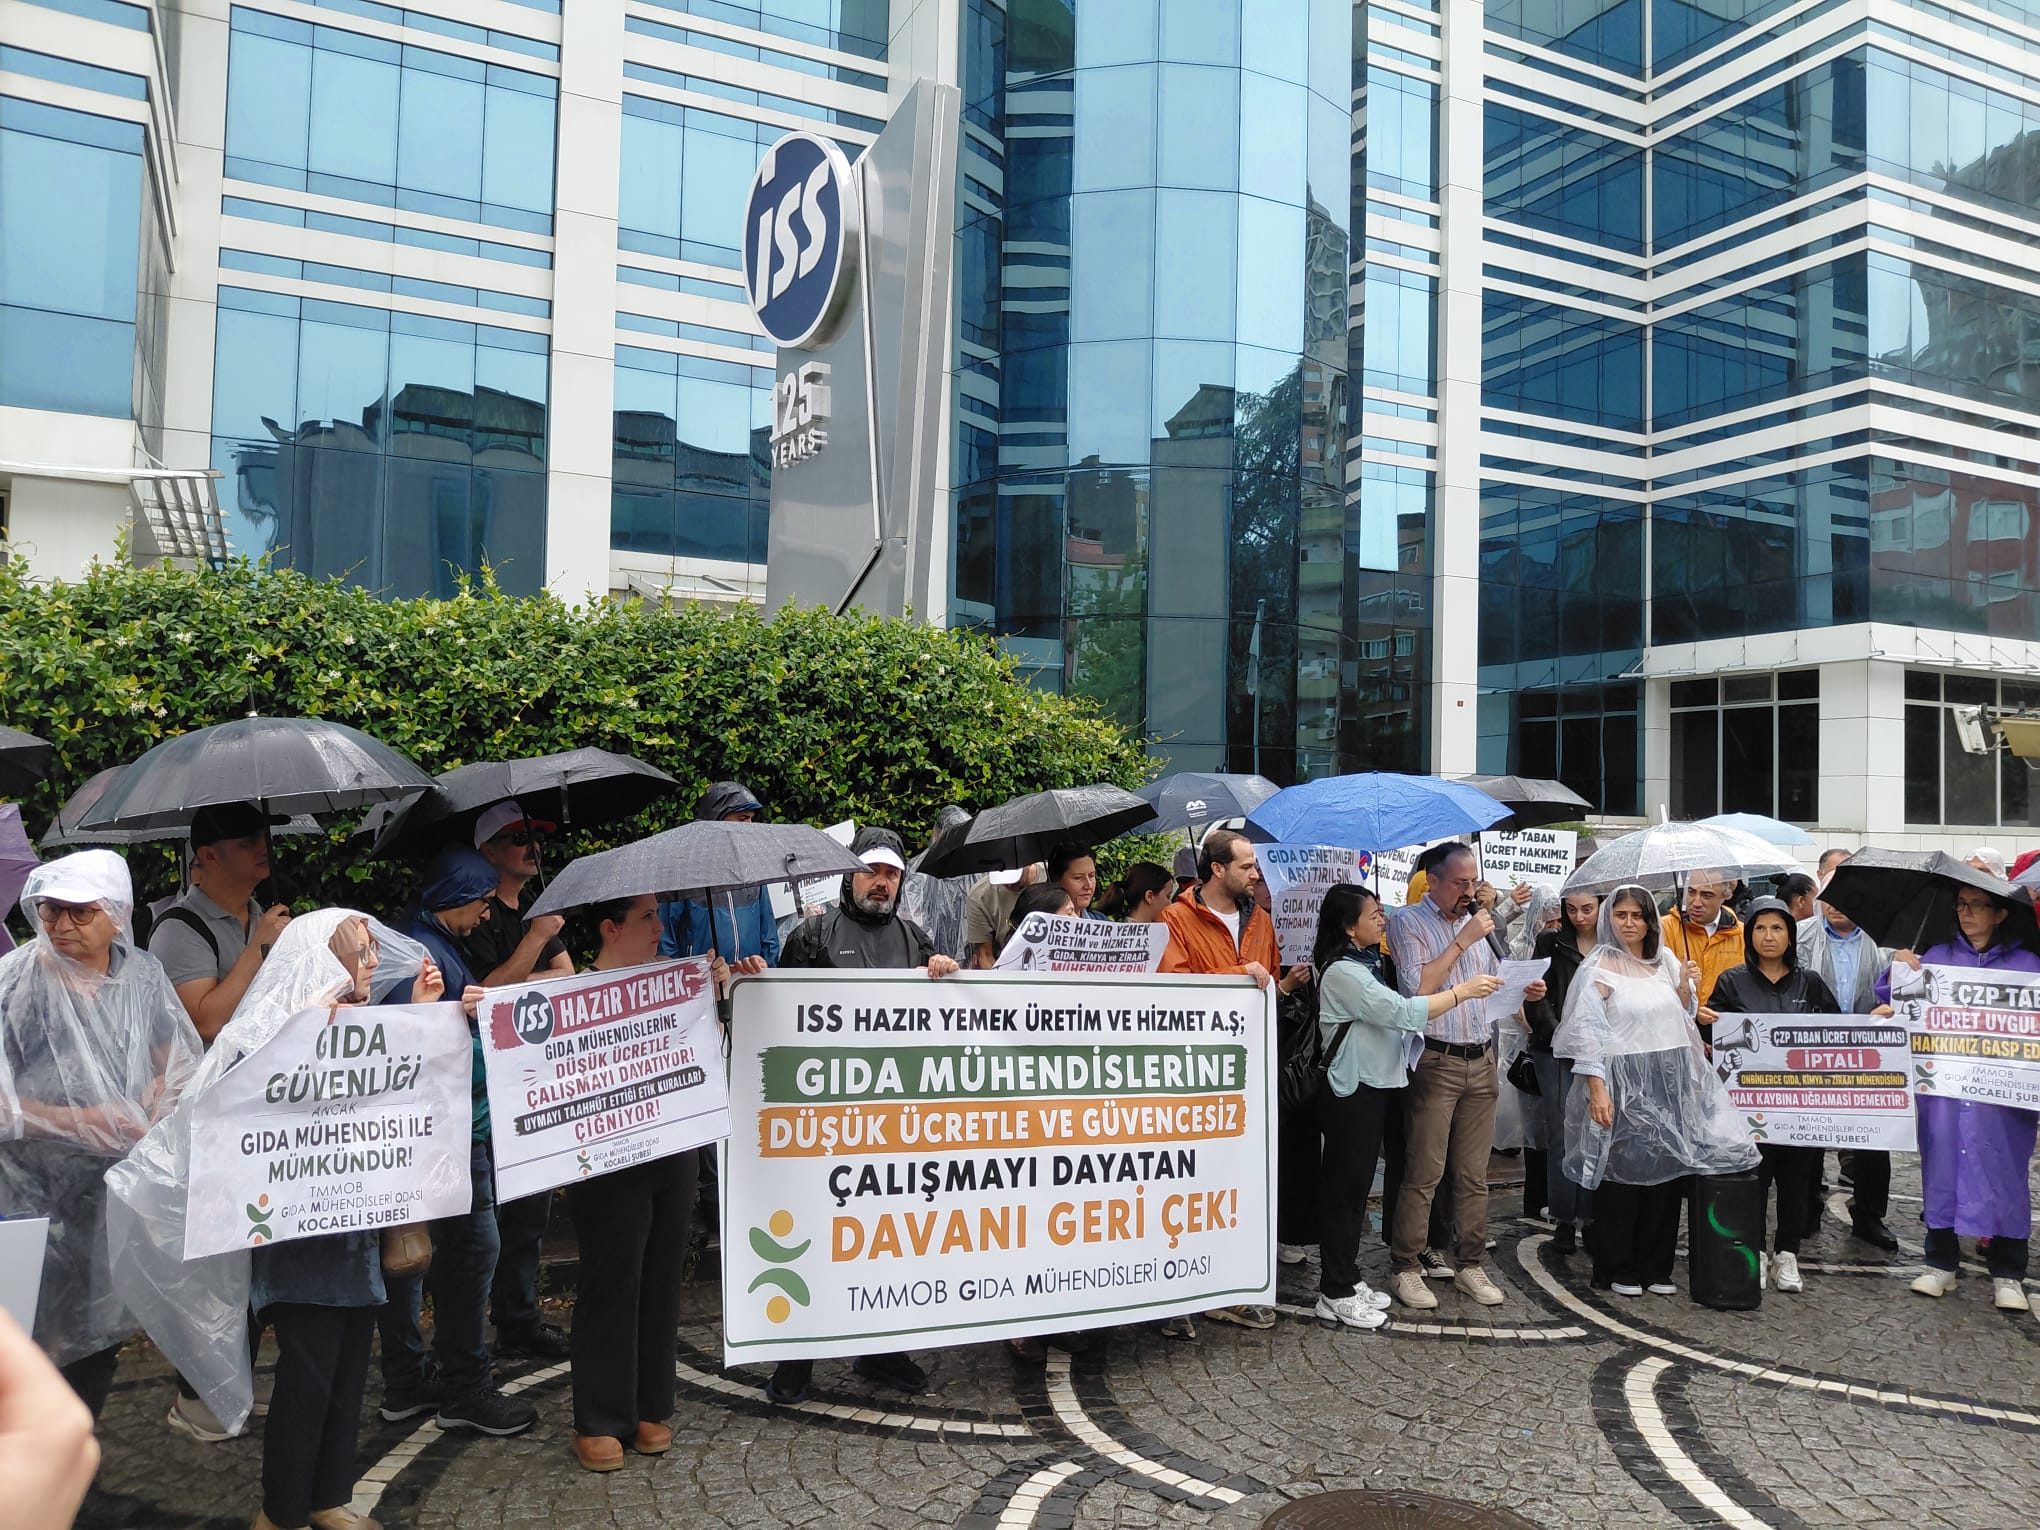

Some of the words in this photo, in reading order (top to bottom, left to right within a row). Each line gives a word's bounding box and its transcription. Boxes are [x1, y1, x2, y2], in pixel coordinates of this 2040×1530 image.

[755, 148, 830, 313] ISS
[769, 361, 814, 443] 125
[771, 427, 817, 468] YEARS
[1500, 831, 1518, 842] ÇZP
[1521, 832, 1555, 843] TABAN
[1267, 850, 1298, 864] GIDA
[1485, 842, 1517, 856] ÜCRET
[1520, 847, 1568, 860] HAKKIMIZ
[1484, 860, 1510, 870] GASP
[1513, 861, 1561, 875] EDİLEMEZ
[1282, 899, 1303, 913] GIDA
[1050, 919, 1070, 934] ISS
[1074, 923, 1112, 937] HAZIR
[1116, 924, 1150, 937] YEMEK
[1047, 933, 1086, 949] ÜRETİM
[1089, 940, 1099, 948] ve
[1102, 937, 1133, 949] HİZMET
[1080, 950, 1106, 962] KİMYA
[1108, 954, 1117, 962] ve
[1119, 951, 1146, 961] ZİRAAT
[1958, 984, 1999, 1008] ÇZP
[797, 1004, 843, 1033] ISS
[854, 1008, 931, 1032] HAZIR
[939, 1008, 1018, 1032] YEMEK
[1025, 1002, 1101, 1032] ÜRETİM
[1107, 1009, 1132, 1032] VE
[1137, 1003, 1206, 1032] HİZMET
[1931, 1008, 1981, 1029] ÜCRET
[1985, 1013, 2039, 1034] UYGUL
[316, 1023, 387, 1061] GIDA
[545, 1039, 575, 1061] GIDA
[578, 1013, 678, 1053] MÜHENDİSLERİNE
[1773, 1032, 1790, 1047] ÇZP
[1793, 1032, 1821, 1044] TABAN
[1822, 1029, 1849, 1044] ÜCRET
[1851, 1031, 1905, 1044] UYGULAMASI
[1912, 1035, 1979, 1055] HAKKIMIZ
[1982, 1038, 2019, 1057] GASP
[556, 1051, 608, 1080] DÜŞÜK
[613, 1035, 670, 1064] ÜCRETLE
[1804, 1050, 1864, 1069] İPTALİ
[265, 1055, 421, 1103] GÜVENLİĞİ
[527, 1072, 615, 1110] ÇALIŞMAYI
[620, 1046, 695, 1082] DAYATIYOR!
[796, 1057, 904, 1096] GIDA
[919, 1045, 1236, 1094] MÜHENDİSLERİNE
[1741, 1073, 1782, 1085] ONBİNLERCE
[1802, 1073, 1824, 1085] KİMYA
[1832, 1073, 1855, 1086] ZİRAAT
[1944, 1073, 1968, 1082] GIDA
[1972, 1066, 2014, 1079] TMMOB
[523, 1110, 562, 1132] UYMAYI
[563, 1097, 607, 1121] TAAHHÜT
[609, 1087, 637, 1111] ETTİĞİ
[639, 1083, 656, 1103] ETİK
[657, 1072, 702, 1094] KURALLARI
[1731, 1092, 1754, 1105] HAK
[1757, 1092, 1799, 1106] KAYBINA
[1854, 1091, 1905, 1107] DEMEKTİR!
[1961, 1086, 2012, 1100] KOCAELİ
[2016, 1091, 2040, 1103] ŞUB
[311, 1103, 358, 1118] ANCAK
[575, 1099, 661, 1144] ÇİĞNİYOR!
[1798, 1116, 1832, 1124] TMMOB
[241, 1129, 289, 1155] GIDA
[295, 1114, 403, 1147] MÜHENDİSİ
[409, 1114, 433, 1138] İLE
[769, 1107, 888, 1156] DÜŞÜK
[901, 1105, 1029, 1144] ÜCRETLE
[1039, 1108, 1073, 1138] VE
[1082, 1097, 1237, 1137] GÜVENCESİZ
[1774, 1123, 1795, 1131] GIDA
[1799, 1123, 1855, 1133] MÜHENDİSLERİ
[1790, 1132, 1833, 1142] KOCAELİ
[1835, 1134, 1870, 1144] ŞUBESİ
[268, 1145, 413, 1183] MÜMKÜNDÜR!
[604, 1151, 630, 1168] KOCAELİ
[829, 1157, 1037, 1207] ÇALIŞMAYI
[1053, 1149, 1196, 1186] DAYATAN
[310, 1182, 363, 1198] TMMOB
[281, 1205, 306, 1218] GIDA
[310, 1191, 392, 1213] MÜHENDİSLERİ
[395, 1190, 423, 1203] ODASI
[297, 1210, 362, 1233] KOCAELİ
[366, 1204, 410, 1227] ŞUBESİ
[831, 1205, 1027, 1262] DAVANI
[1047, 1185, 1145, 1246] GERİ
[1161, 1189, 1238, 1249] ÇEK!
[847, 1280, 948, 1311] TMMOB
[959, 1277, 1015, 1301] GIDA
[1025, 1258, 1157, 1295] MÜHENDİSLERİ
[1163, 1255, 1211, 1280] ODASI
